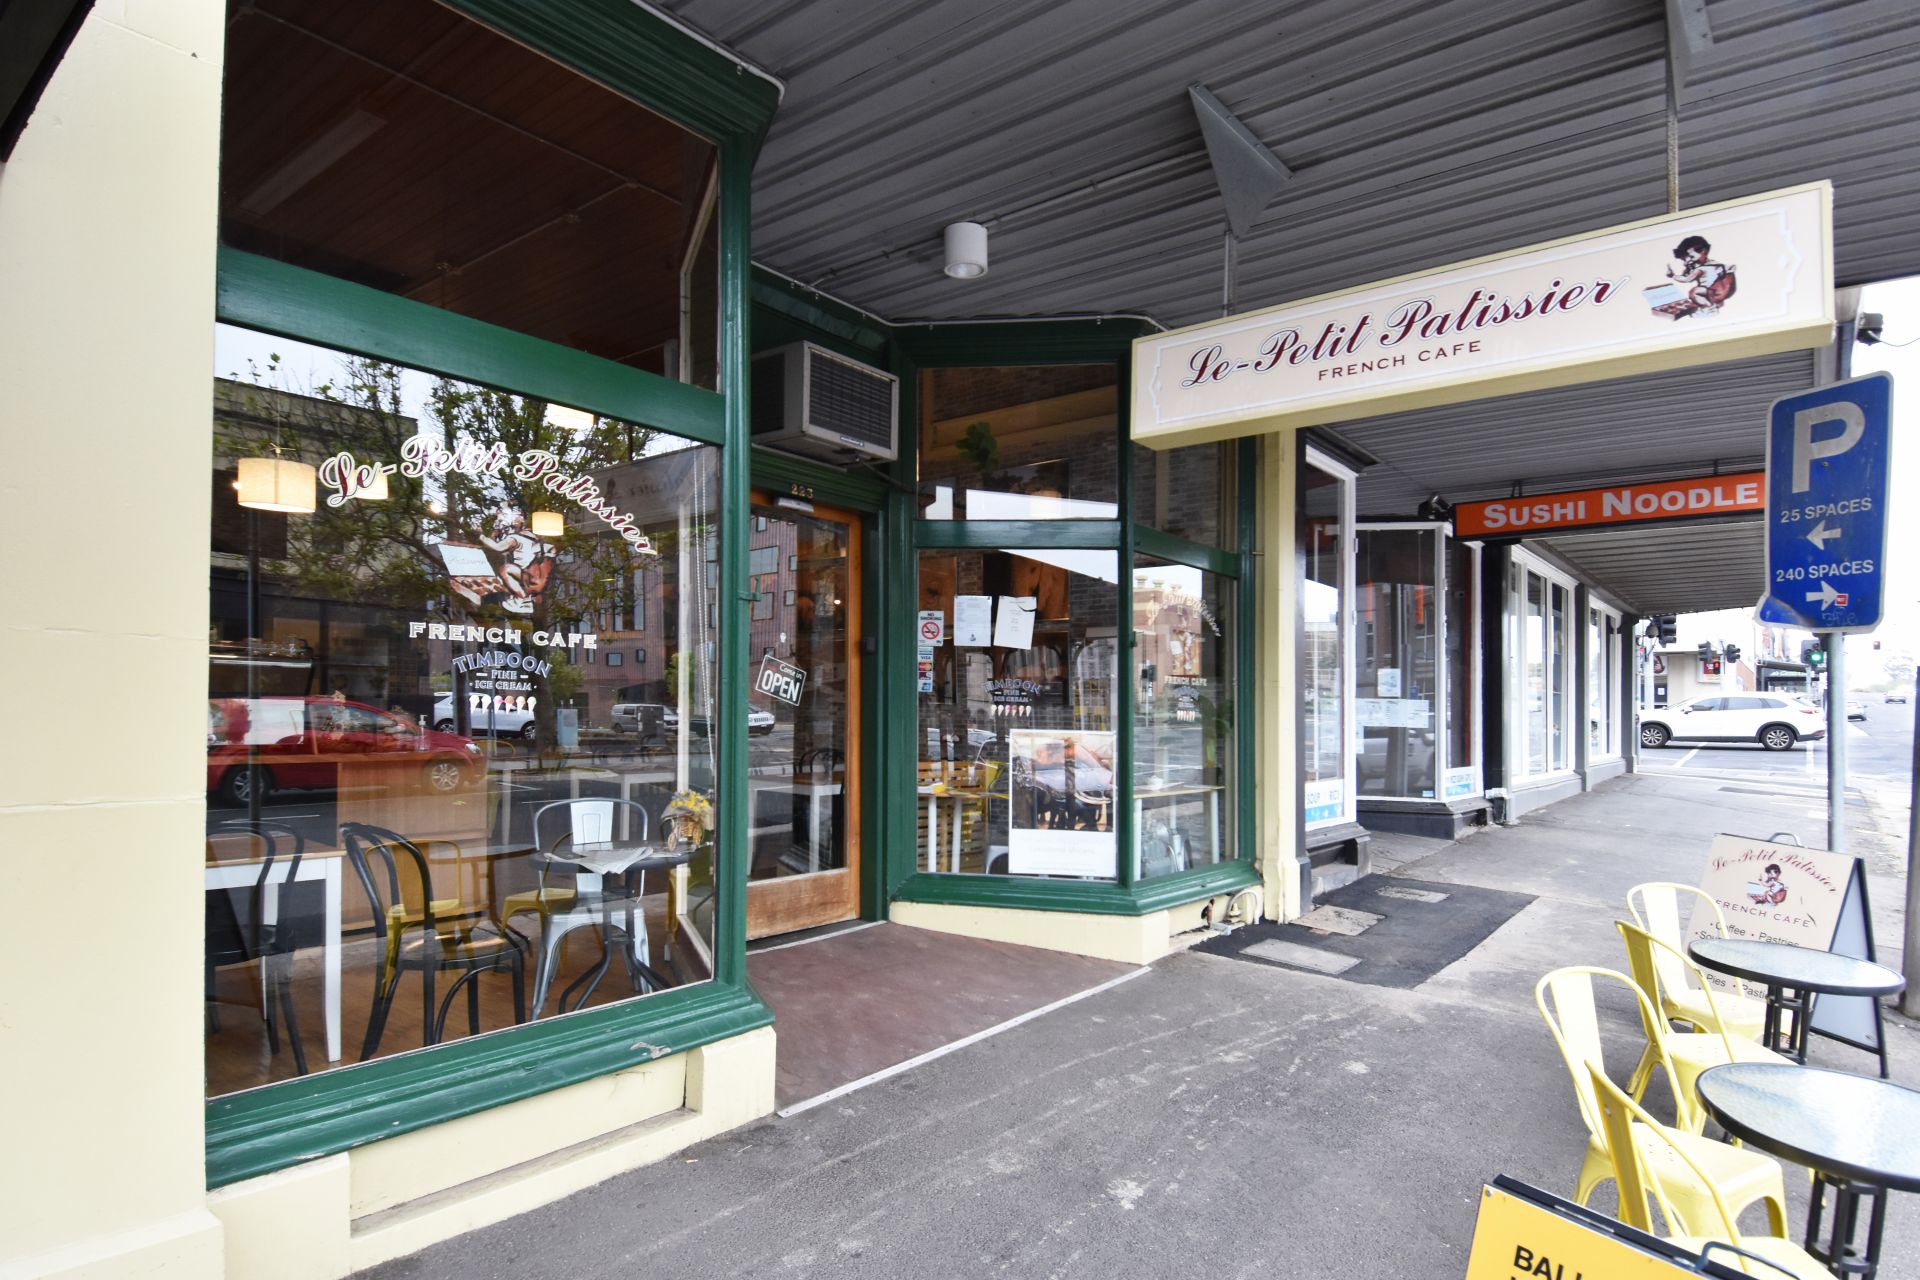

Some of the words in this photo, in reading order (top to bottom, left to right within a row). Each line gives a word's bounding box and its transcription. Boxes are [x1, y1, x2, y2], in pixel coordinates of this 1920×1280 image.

[1379, 275, 1632, 348] Patissier
[1317, 354, 1406, 381] FRENCH
[1417, 340, 1482, 363] CAFE
[1792, 401, 1866, 494] P
[512, 448, 658, 556] Patissier
[1780, 509, 1801, 524] 25
[1804, 497, 1873, 521] SPACES
[1775, 566, 1805, 582] 240
[1808, 559, 1874, 580] SPACES
[409, 621, 522, 645] FRENCH
[532, 630, 598, 650] CAFE
[453, 650, 553, 679] TIMBOON
[475, 679, 494, 690] ICE
[495, 681, 533, 691] CREAM
[761, 669, 801, 702] OPEN
[1715, 899, 1768, 918] FRENCH
[1773, 913, 1811, 929] CAFE
